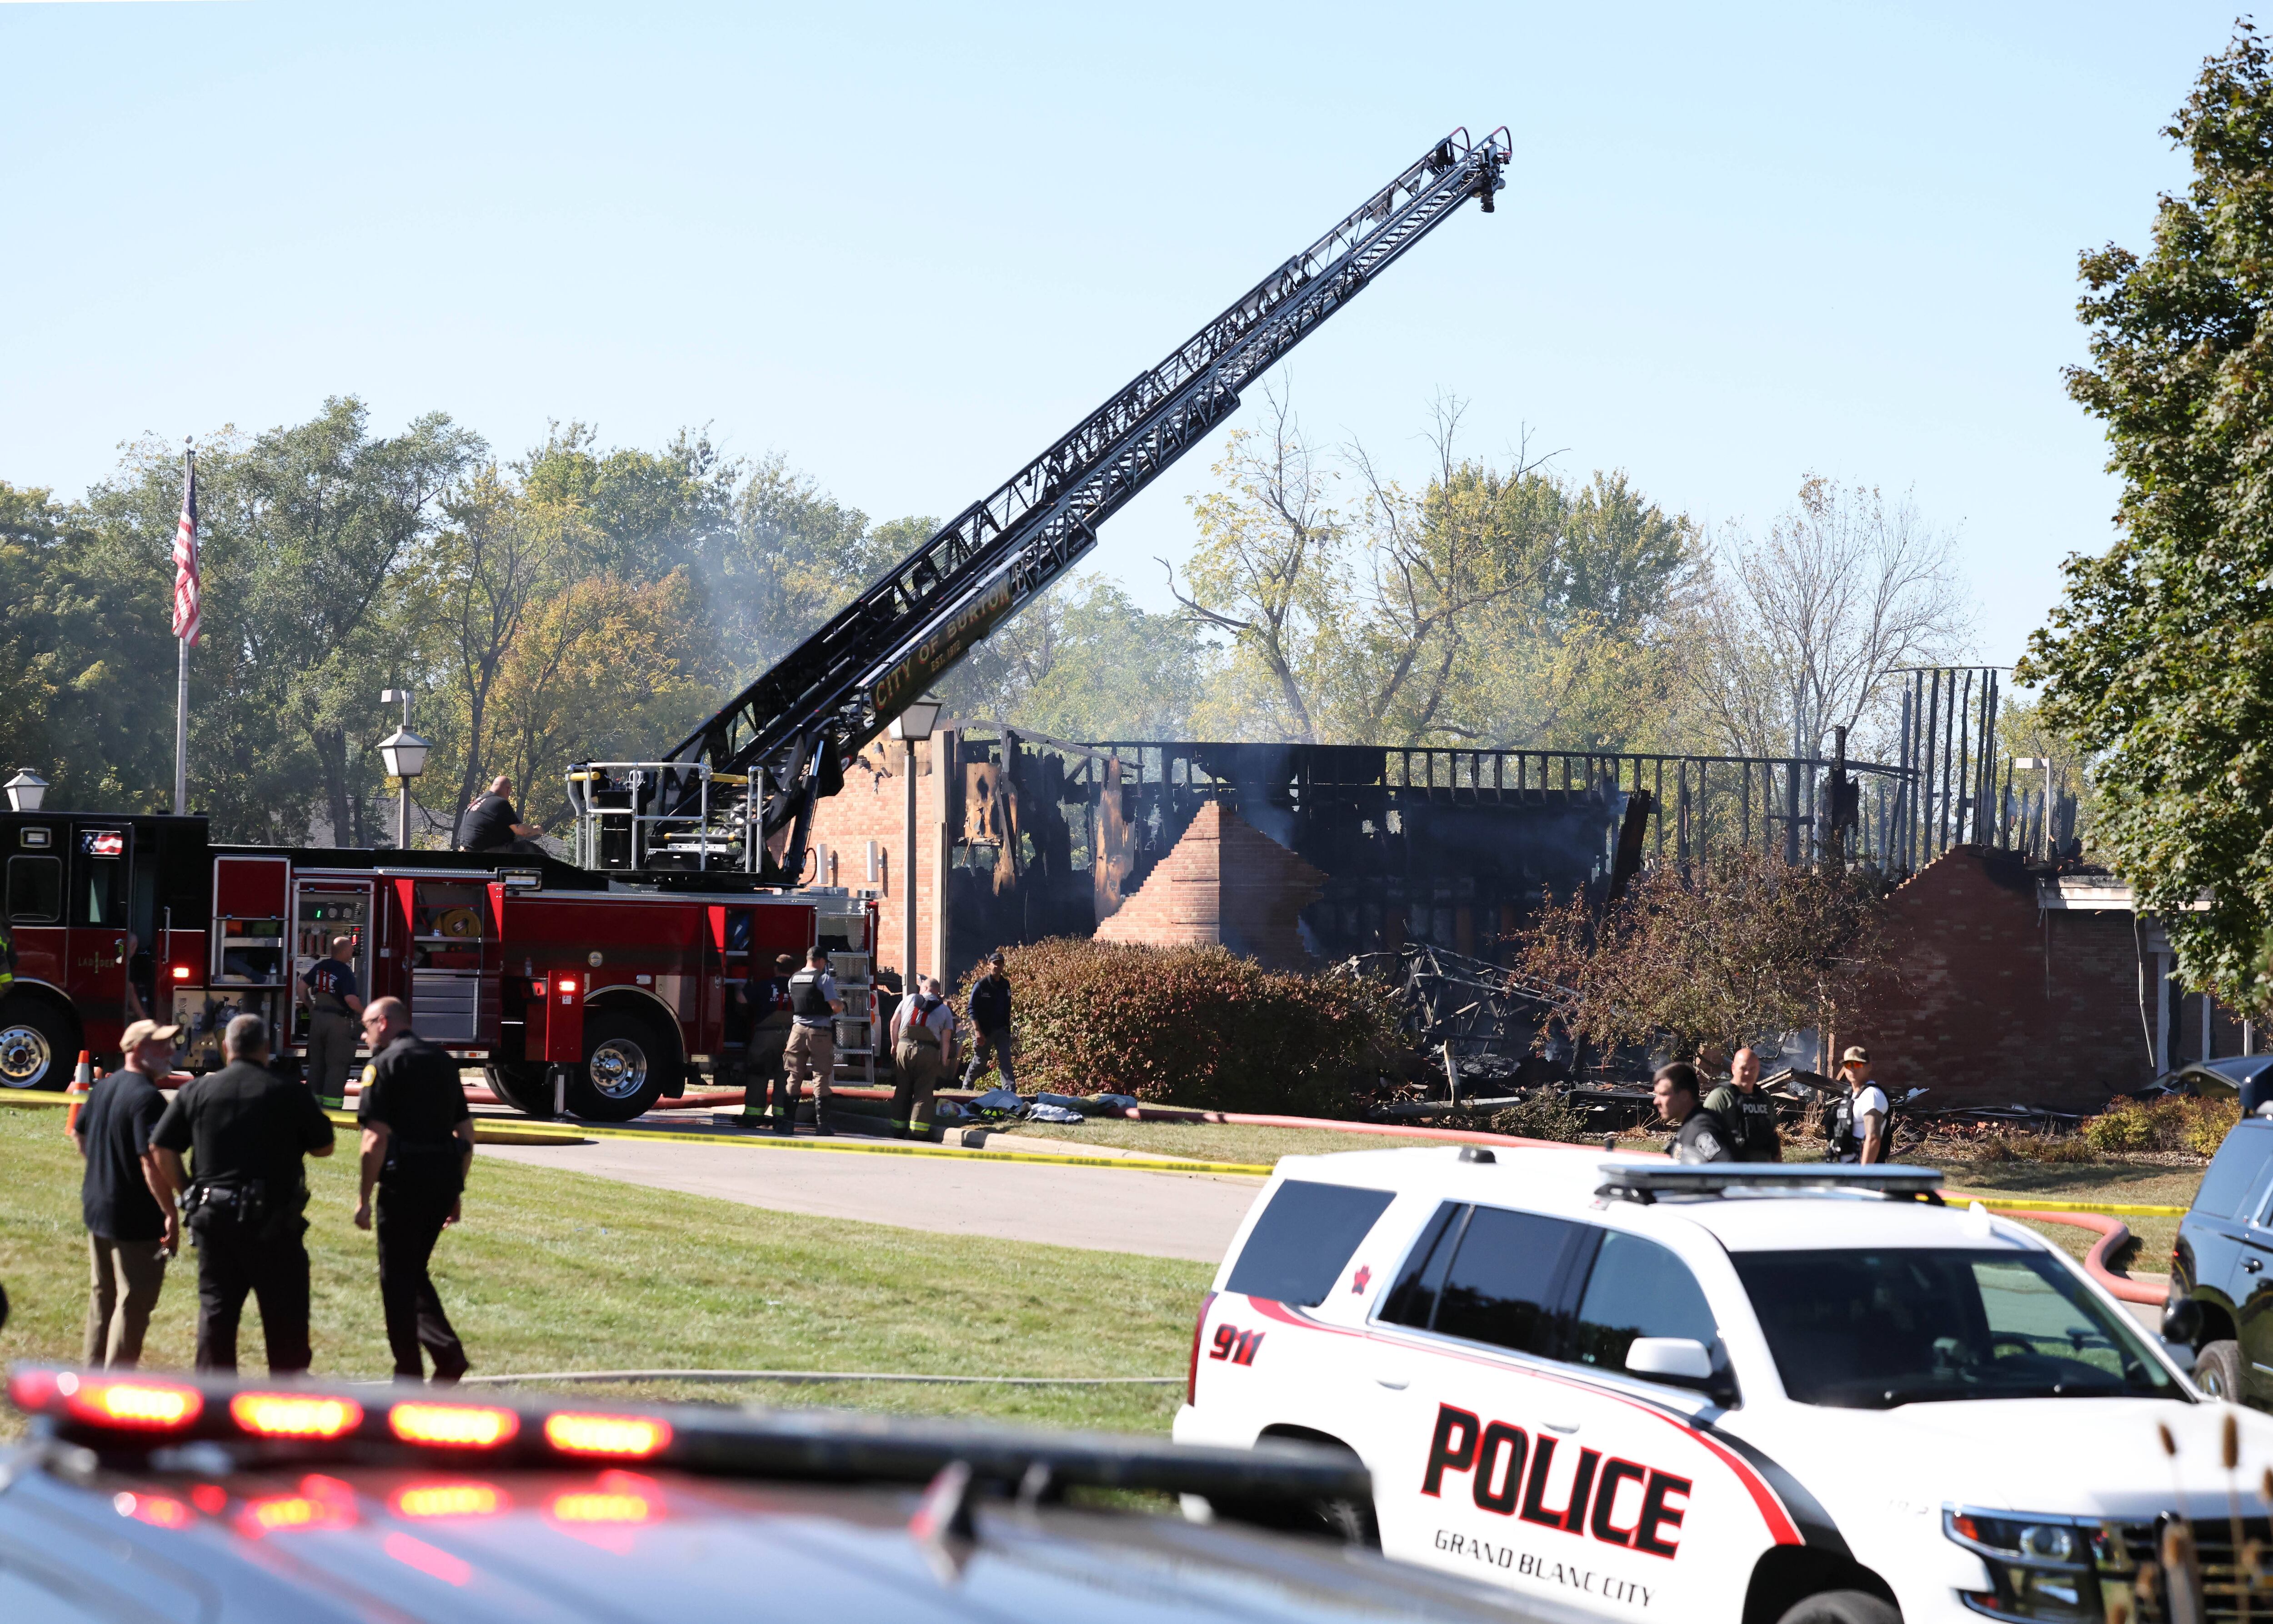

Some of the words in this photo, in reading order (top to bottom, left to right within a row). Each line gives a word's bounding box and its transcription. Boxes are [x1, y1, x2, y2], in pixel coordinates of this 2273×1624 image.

[876, 657, 911, 710] CITY
[919, 634, 939, 664] OF
[946, 576, 1010, 641] BURTON
[931, 654, 946, 672] EST.
[1742, 1103, 1768, 1114] POLICE
[1209, 1323, 1266, 1367] 911
[1421, 1402, 1693, 1560] POLICE
[1435, 1529, 1513, 1569] GRAND
[1518, 1553, 1597, 1592] BLANC
[1603, 1577, 1655, 1608] CITY
